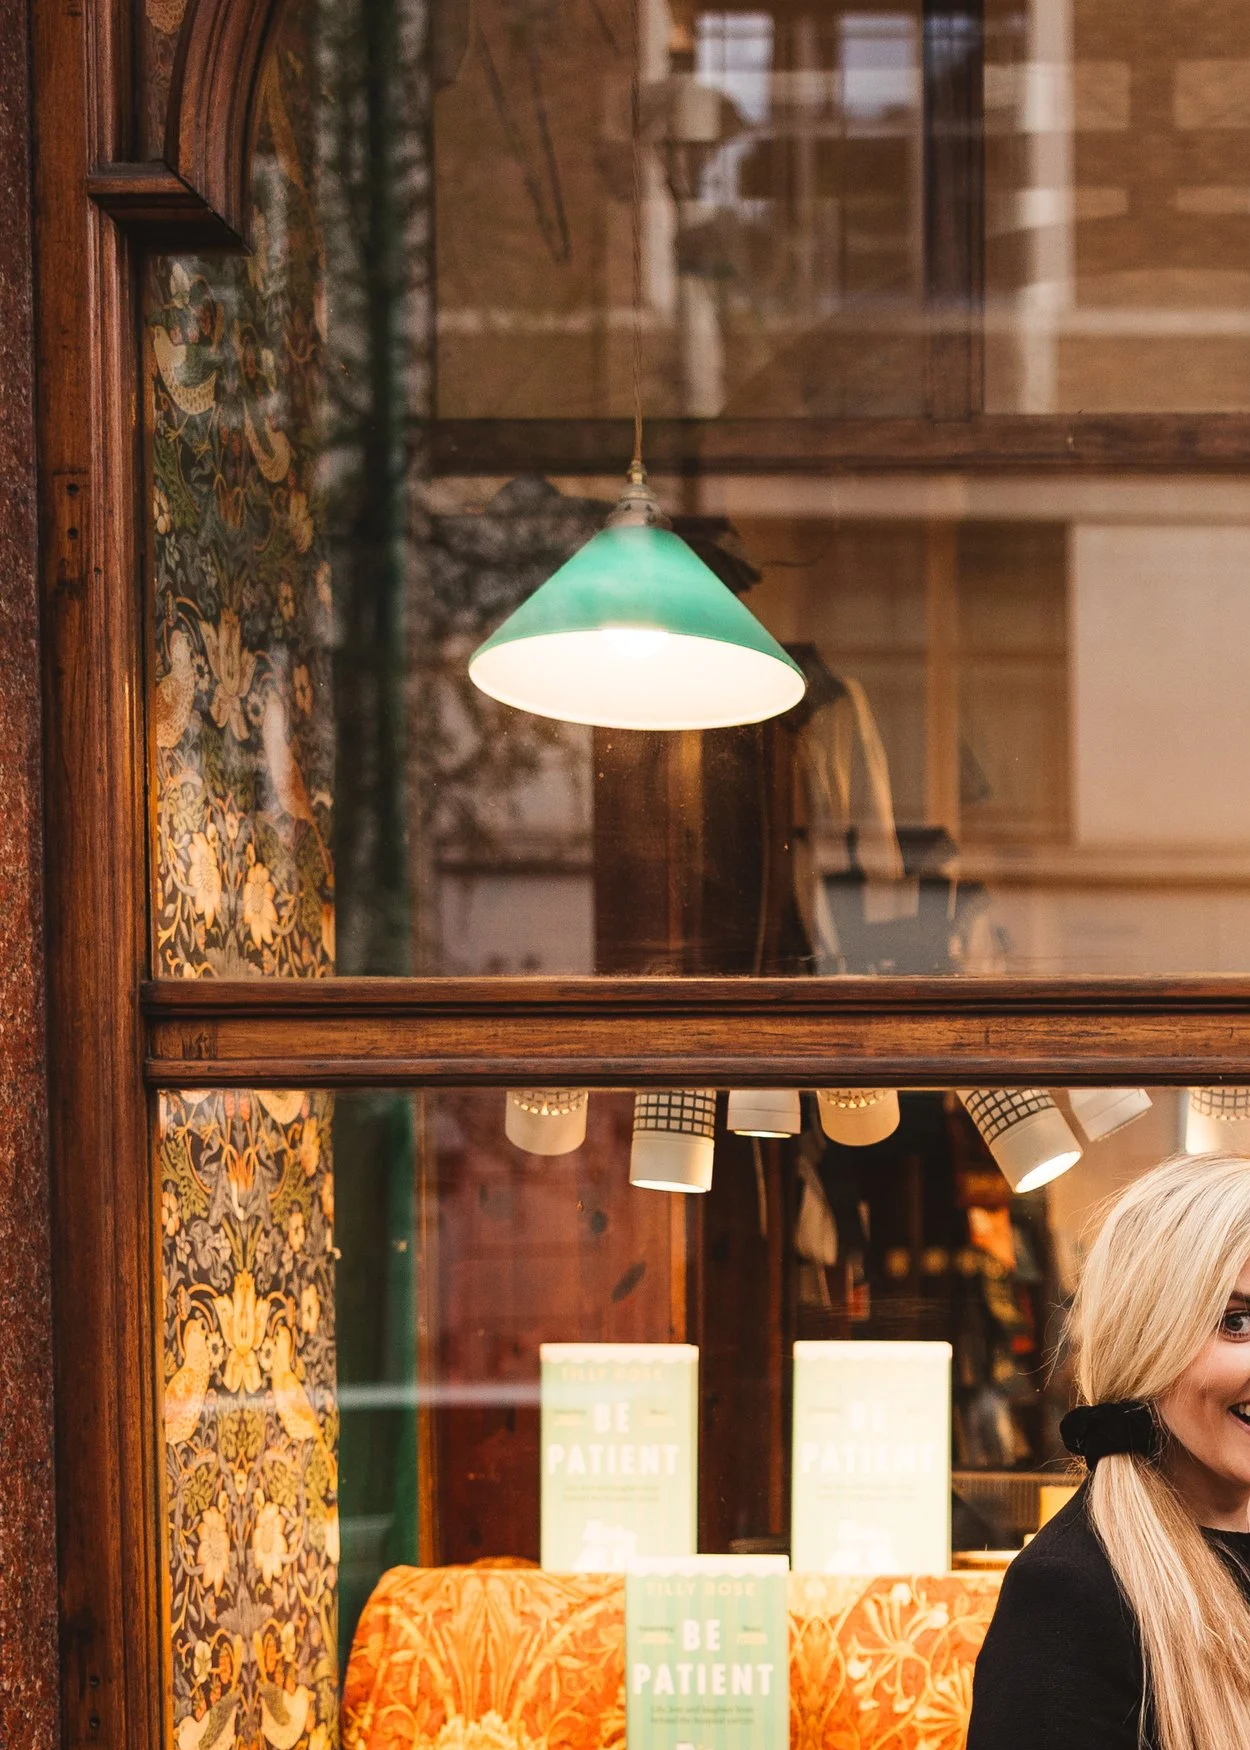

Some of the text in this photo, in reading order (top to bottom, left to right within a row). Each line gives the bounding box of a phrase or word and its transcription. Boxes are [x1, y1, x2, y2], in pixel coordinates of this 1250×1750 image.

[594, 1402, 630, 1433] BE
[548, 1443, 679, 1475] PATIENT
[646, 1582, 755, 1596] TILLY ROSE
[683, 1619, 720, 1651] BE
[633, 1663, 774, 1695] PATIENT
